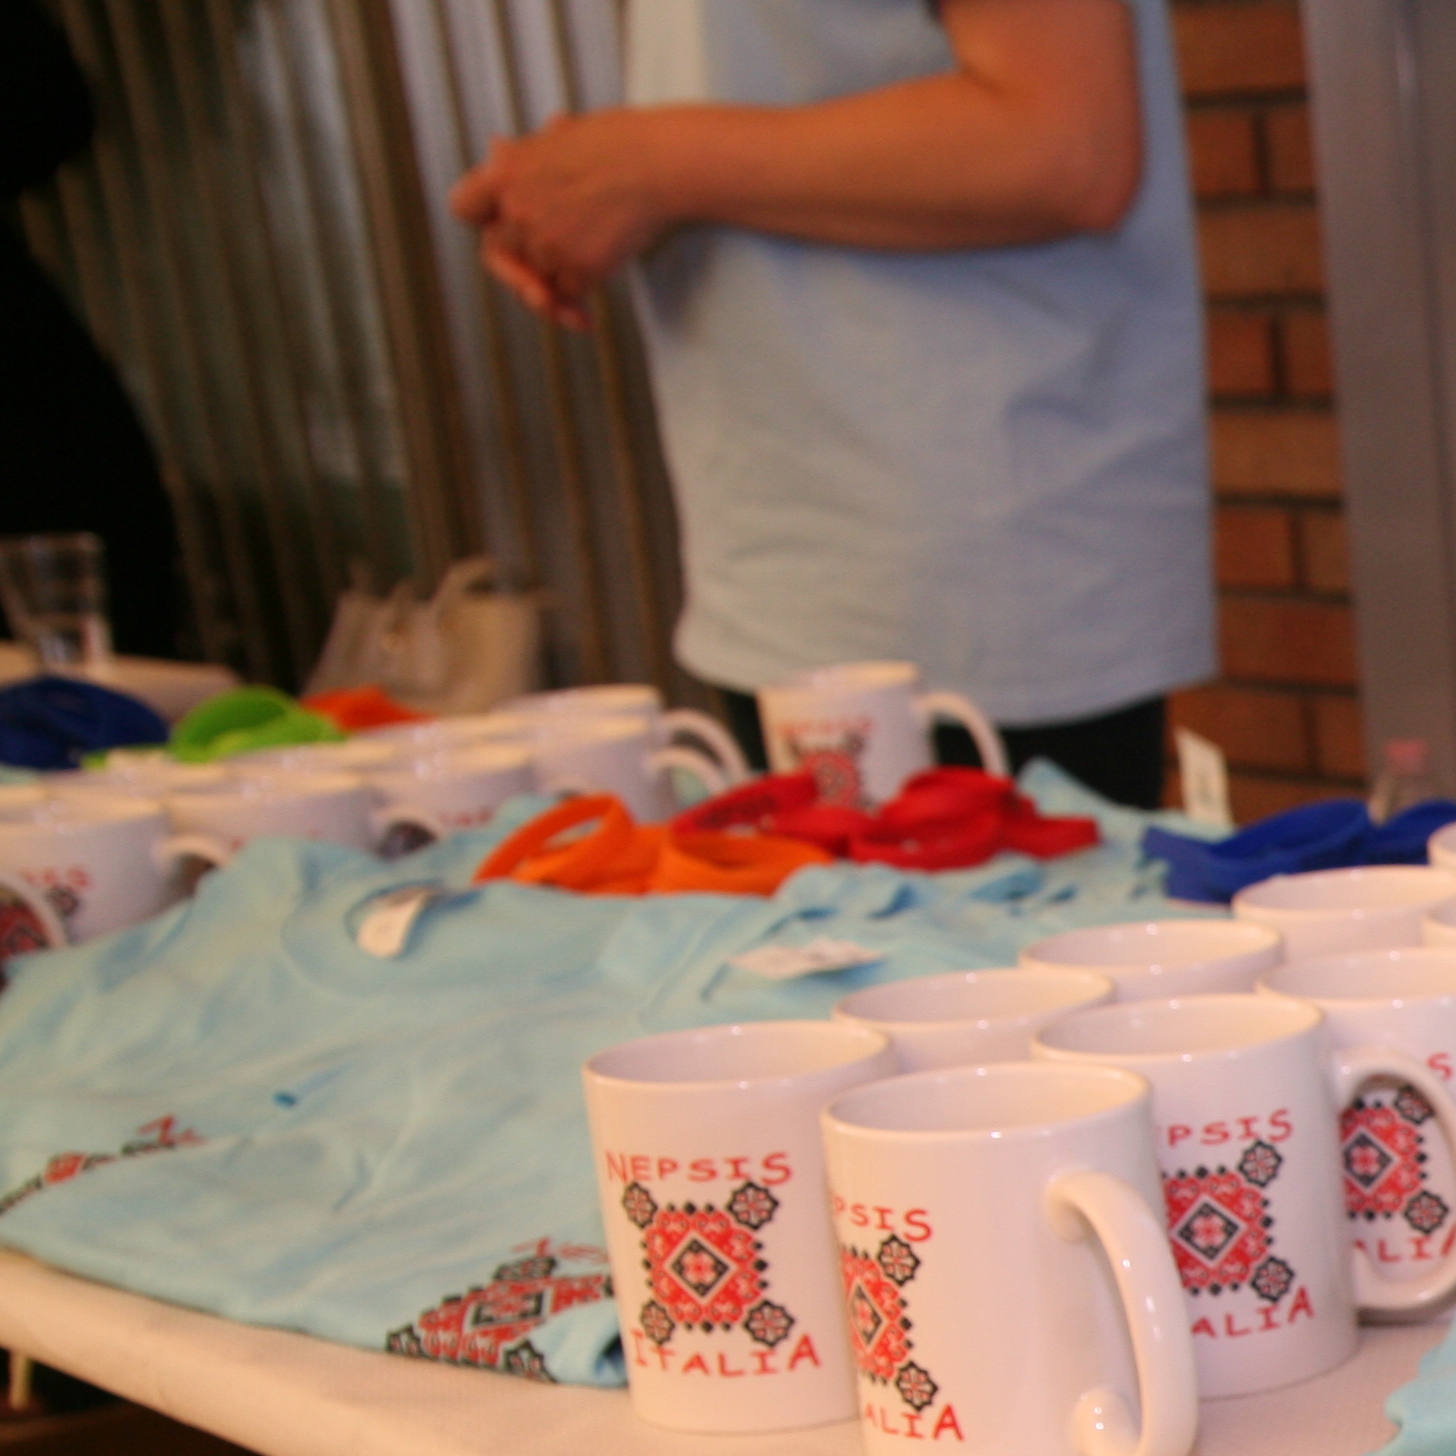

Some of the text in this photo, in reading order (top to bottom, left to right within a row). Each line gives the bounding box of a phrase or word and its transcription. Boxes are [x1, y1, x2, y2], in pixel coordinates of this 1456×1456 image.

[1167, 1109, 1293, 1146] PSIS
[605, 1151, 793, 1186] NEPSIS
[832, 1196, 933, 1242] PSIS
[1191, 1286, 1314, 1338] ALIA
[631, 1330, 821, 1377] ITALIA
[864, 1403, 965, 1441] ALIA
